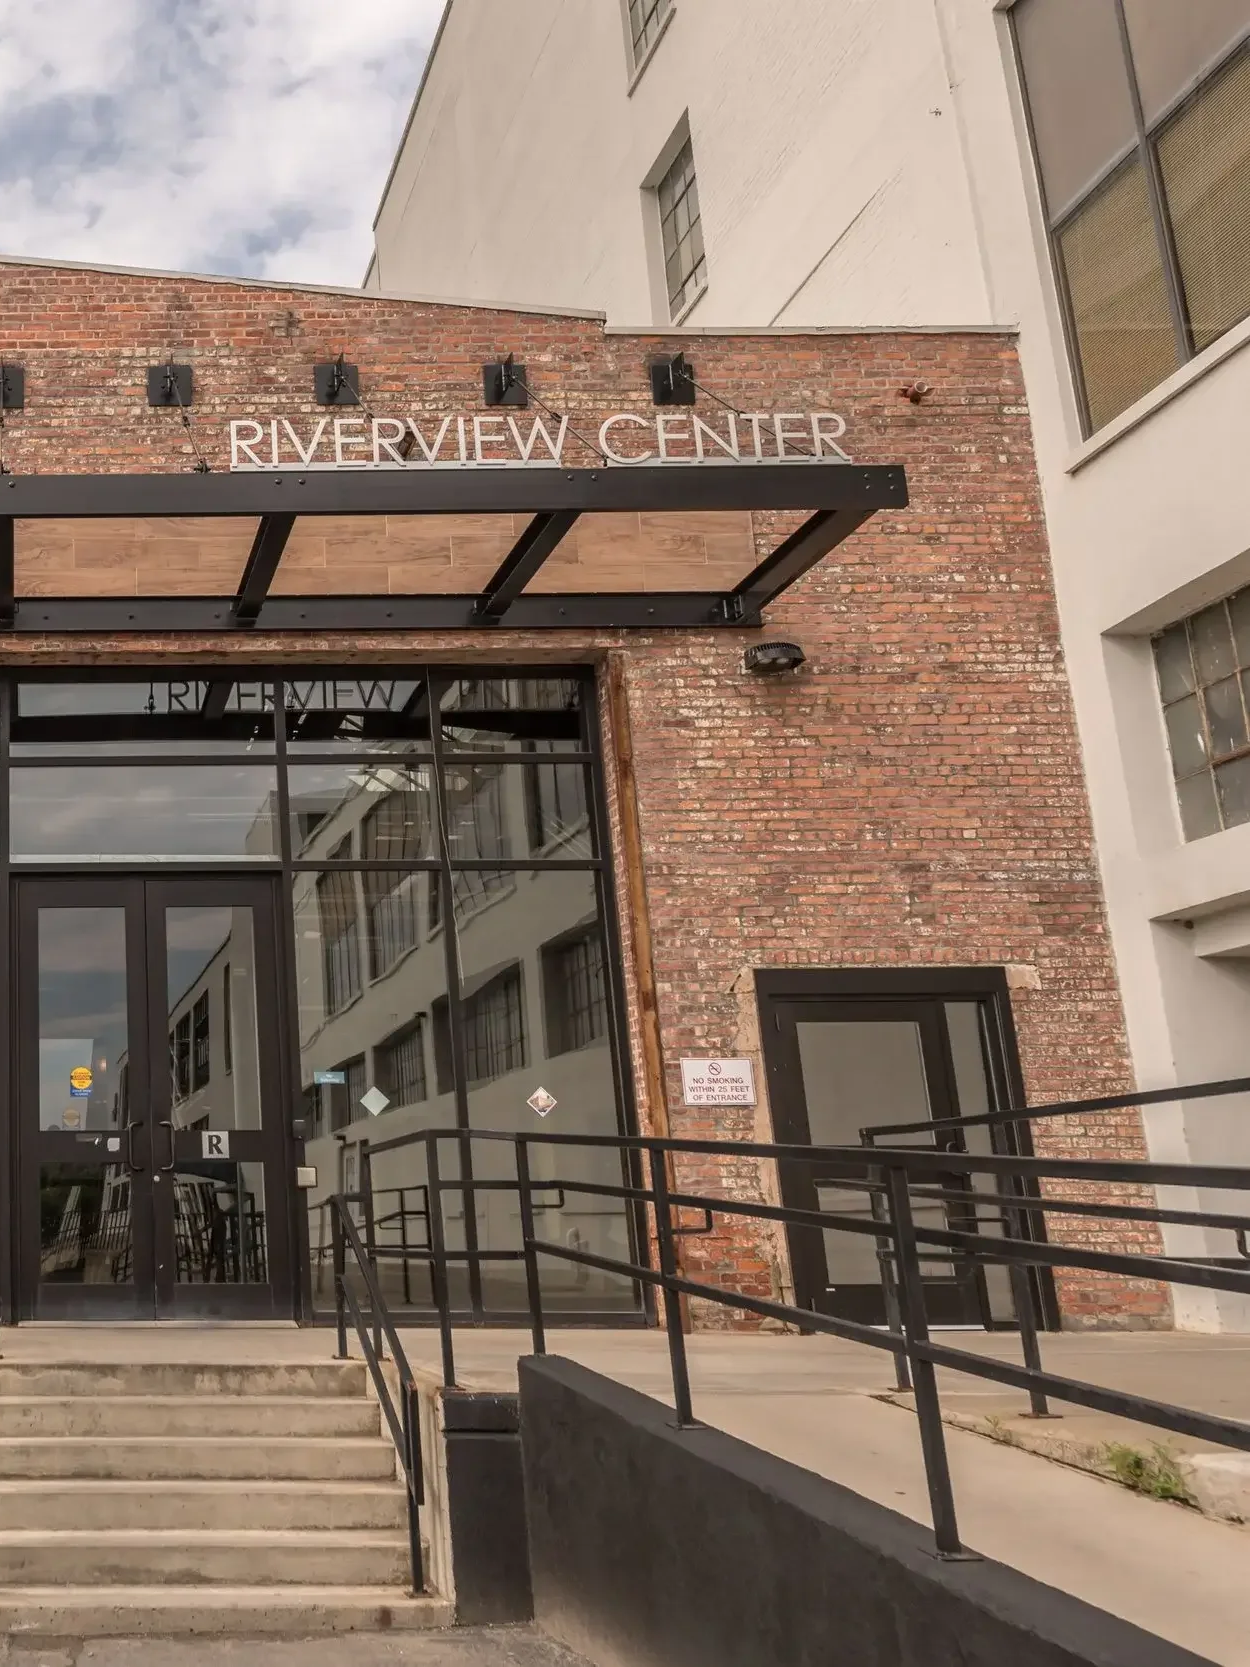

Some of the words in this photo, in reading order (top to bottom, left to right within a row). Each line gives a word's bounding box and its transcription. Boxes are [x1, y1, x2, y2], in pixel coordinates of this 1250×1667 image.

[230, 415, 568, 467] RIVERVIEW
[599, 413, 852, 465] CENTER
[208, 1135, 223, 1154] R
